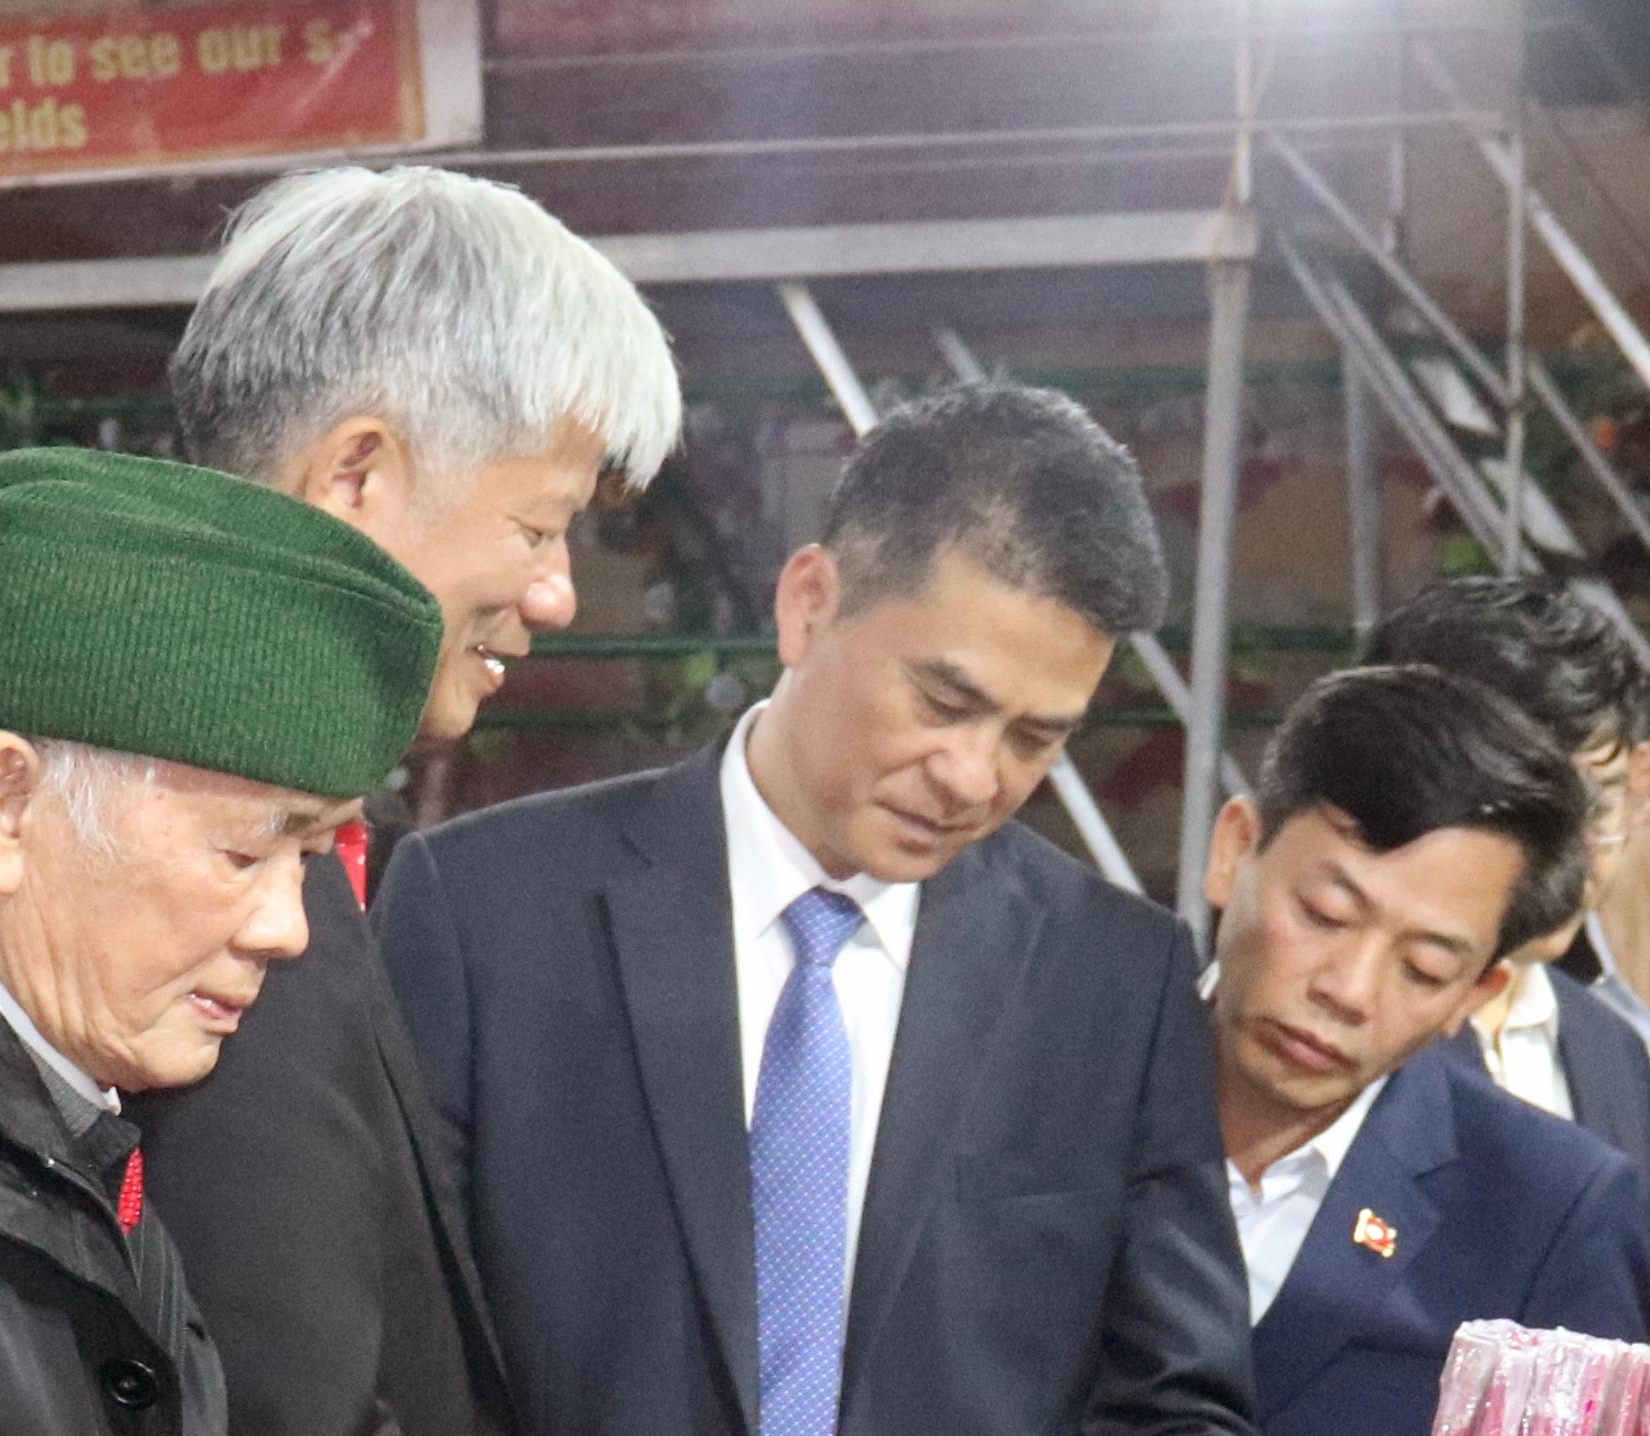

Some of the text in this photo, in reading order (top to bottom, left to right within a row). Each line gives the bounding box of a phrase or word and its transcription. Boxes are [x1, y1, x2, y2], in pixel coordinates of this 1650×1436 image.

[29, 34, 74, 87] to
[89, 31, 181, 82] see
[197, 22, 282, 72] our
